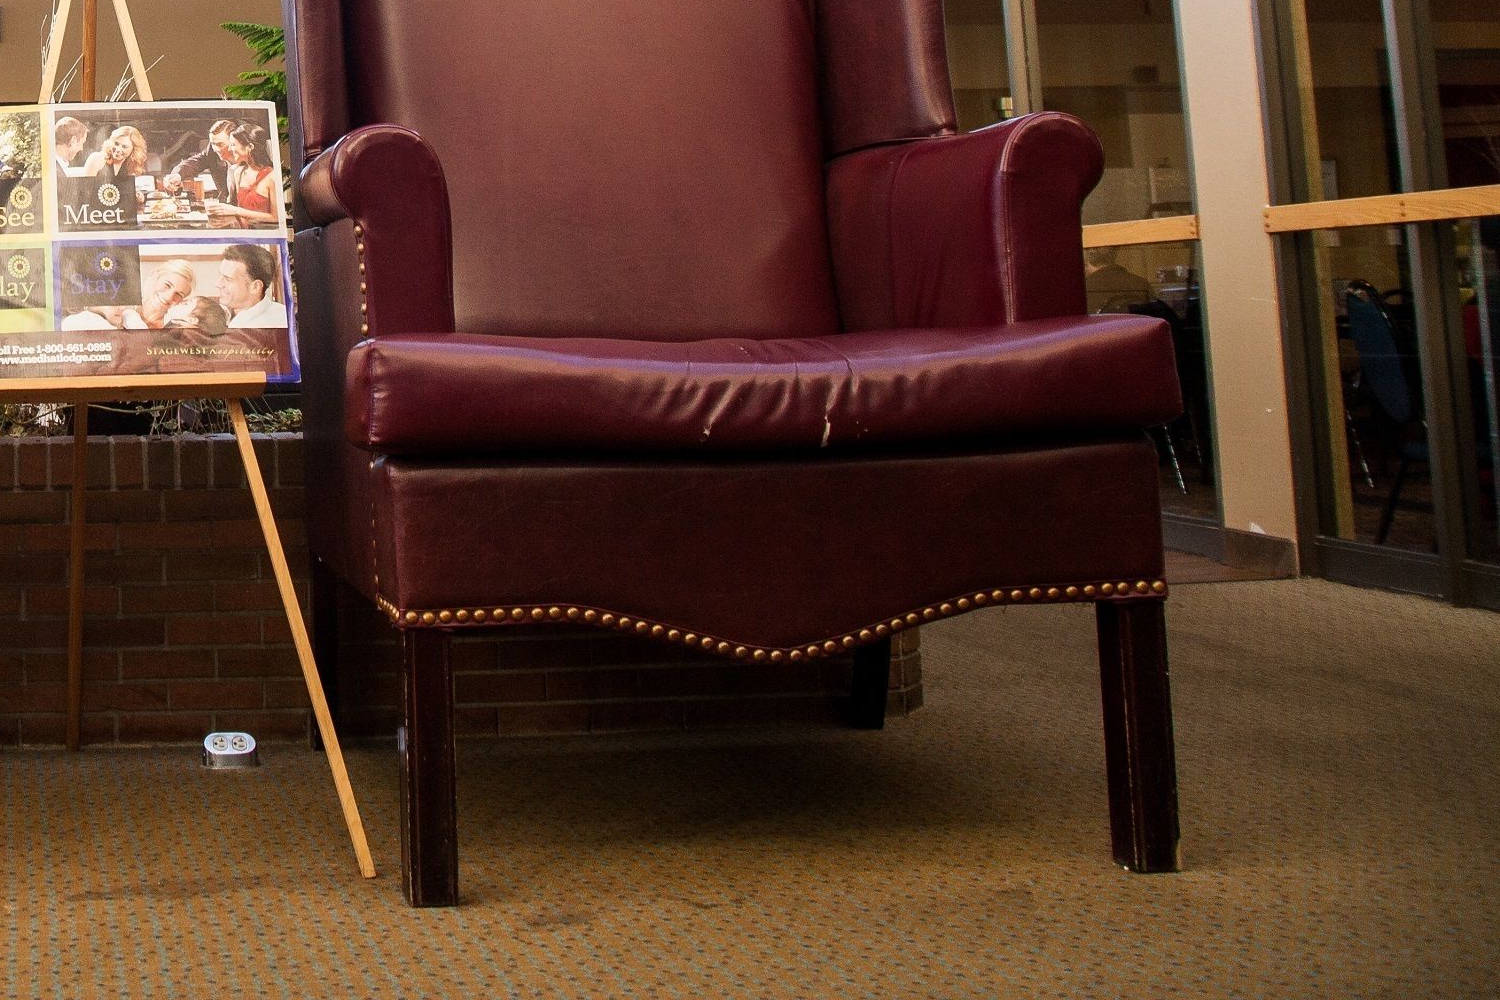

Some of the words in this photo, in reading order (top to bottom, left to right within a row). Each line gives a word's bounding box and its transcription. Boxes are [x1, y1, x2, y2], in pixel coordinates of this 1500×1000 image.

[64, 204, 125, 225] Meet
[70, 273, 125, 300] Stay
[12, 345, 35, 355] Free
[146, 347, 206, 356] STAGEWEST
